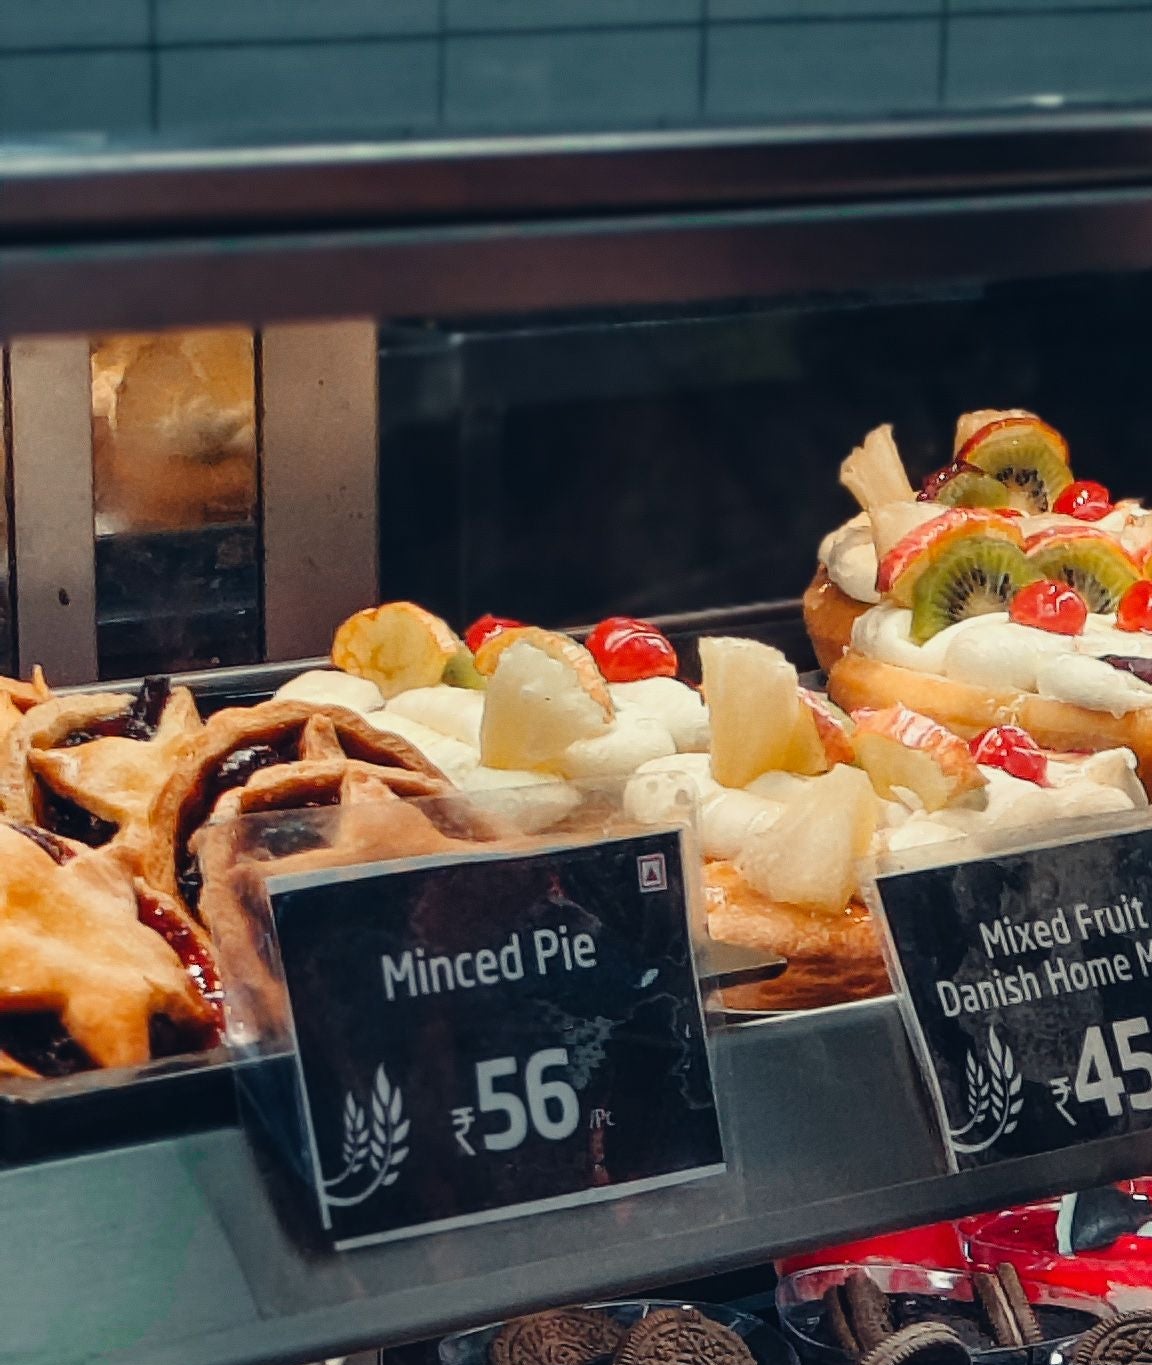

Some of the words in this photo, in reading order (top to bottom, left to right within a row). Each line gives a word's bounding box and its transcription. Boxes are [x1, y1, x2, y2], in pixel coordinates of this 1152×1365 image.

[979, 907, 1072, 960] Mixed
[1076, 894, 1149, 941] Fruit
[381, 934, 524, 1000] Minced
[533, 925, 597, 975] Pie
[937, 963, 1041, 1017] Danish
[1044, 950, 1133, 996] Home
